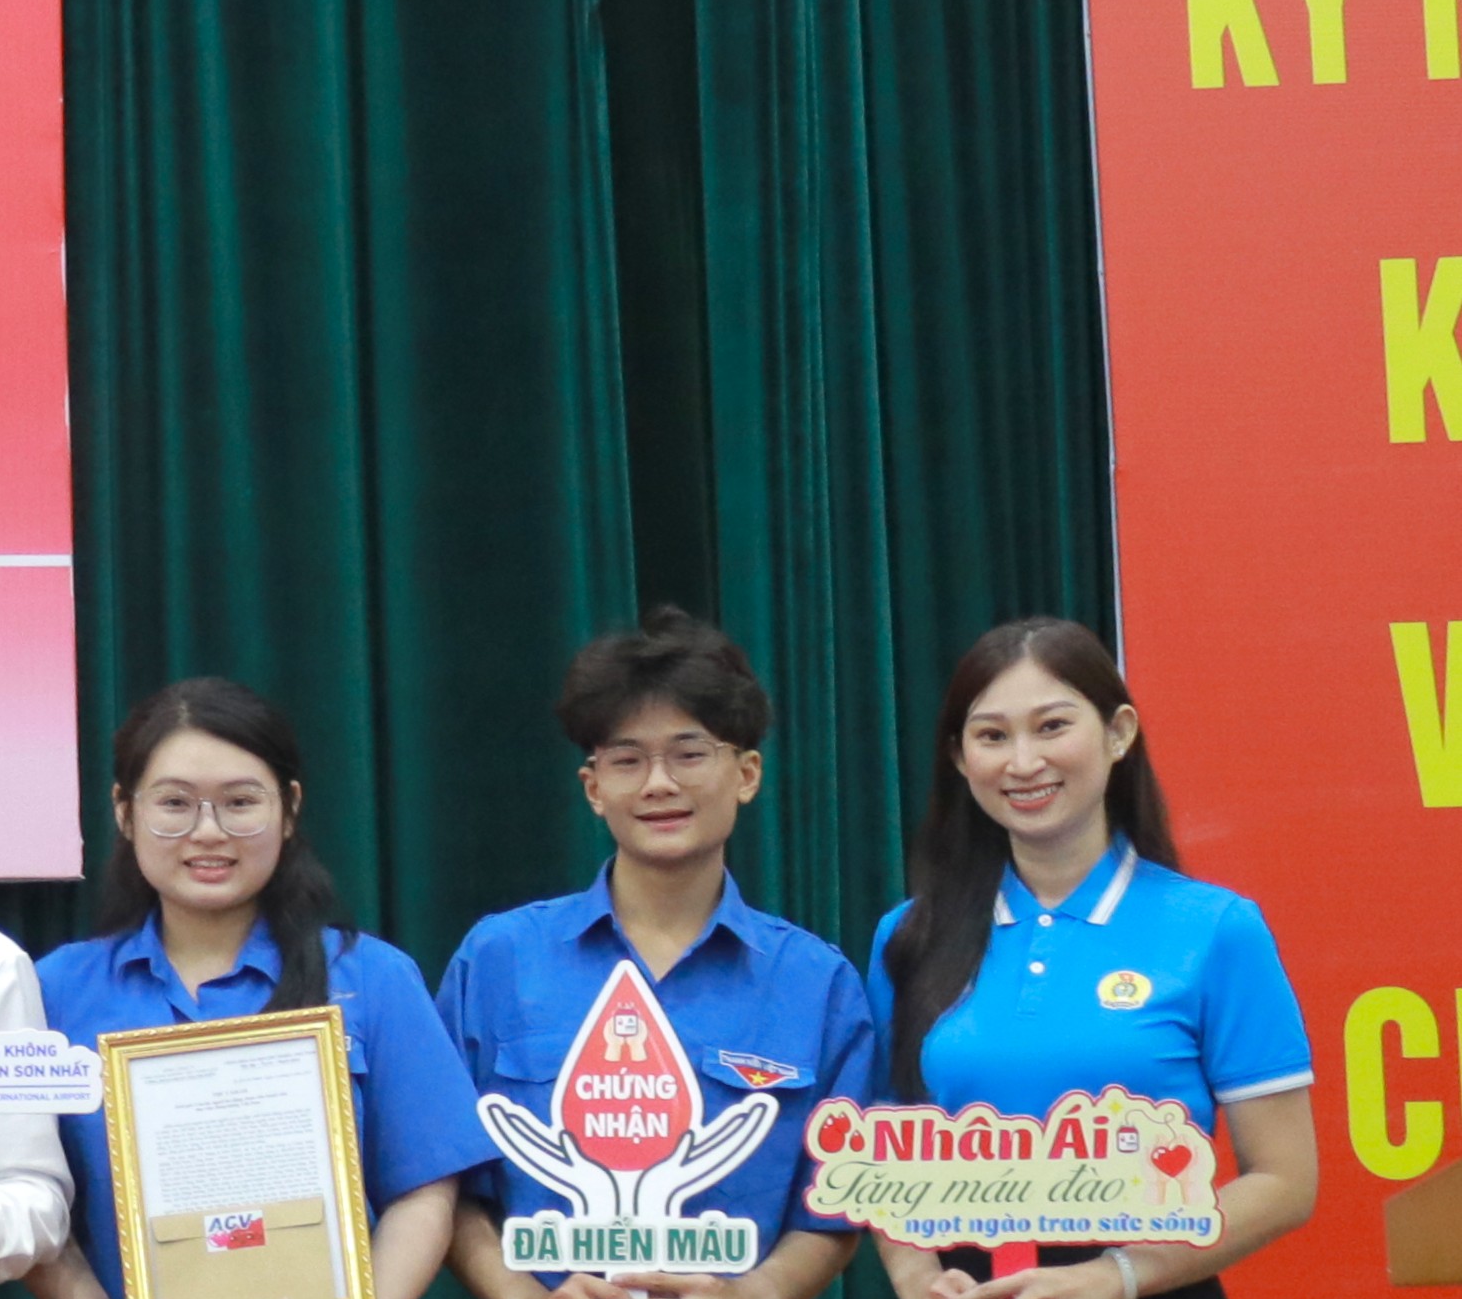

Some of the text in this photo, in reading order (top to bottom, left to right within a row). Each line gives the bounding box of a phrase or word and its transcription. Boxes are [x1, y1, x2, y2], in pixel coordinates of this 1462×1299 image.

[4, 1041, 57, 1058] KHÔNG
[14, 1063, 46, 1078] SƠN
[49, 1059, 91, 1077] NHẤT
[574, 1068, 678, 1101] CHỨNG
[584, 1106, 670, 1145] NHẬN
[872, 1103, 1110, 1162] Nhân Ái
[817, 1159, 1126, 1218] Tặng máu đào
[208, 1212, 254, 1233] ACV
[513, 1215, 747, 1262] ĐÃ HIẾN MÁU
[905, 1206, 1212, 1238] ngọt ngào trao sức sống
